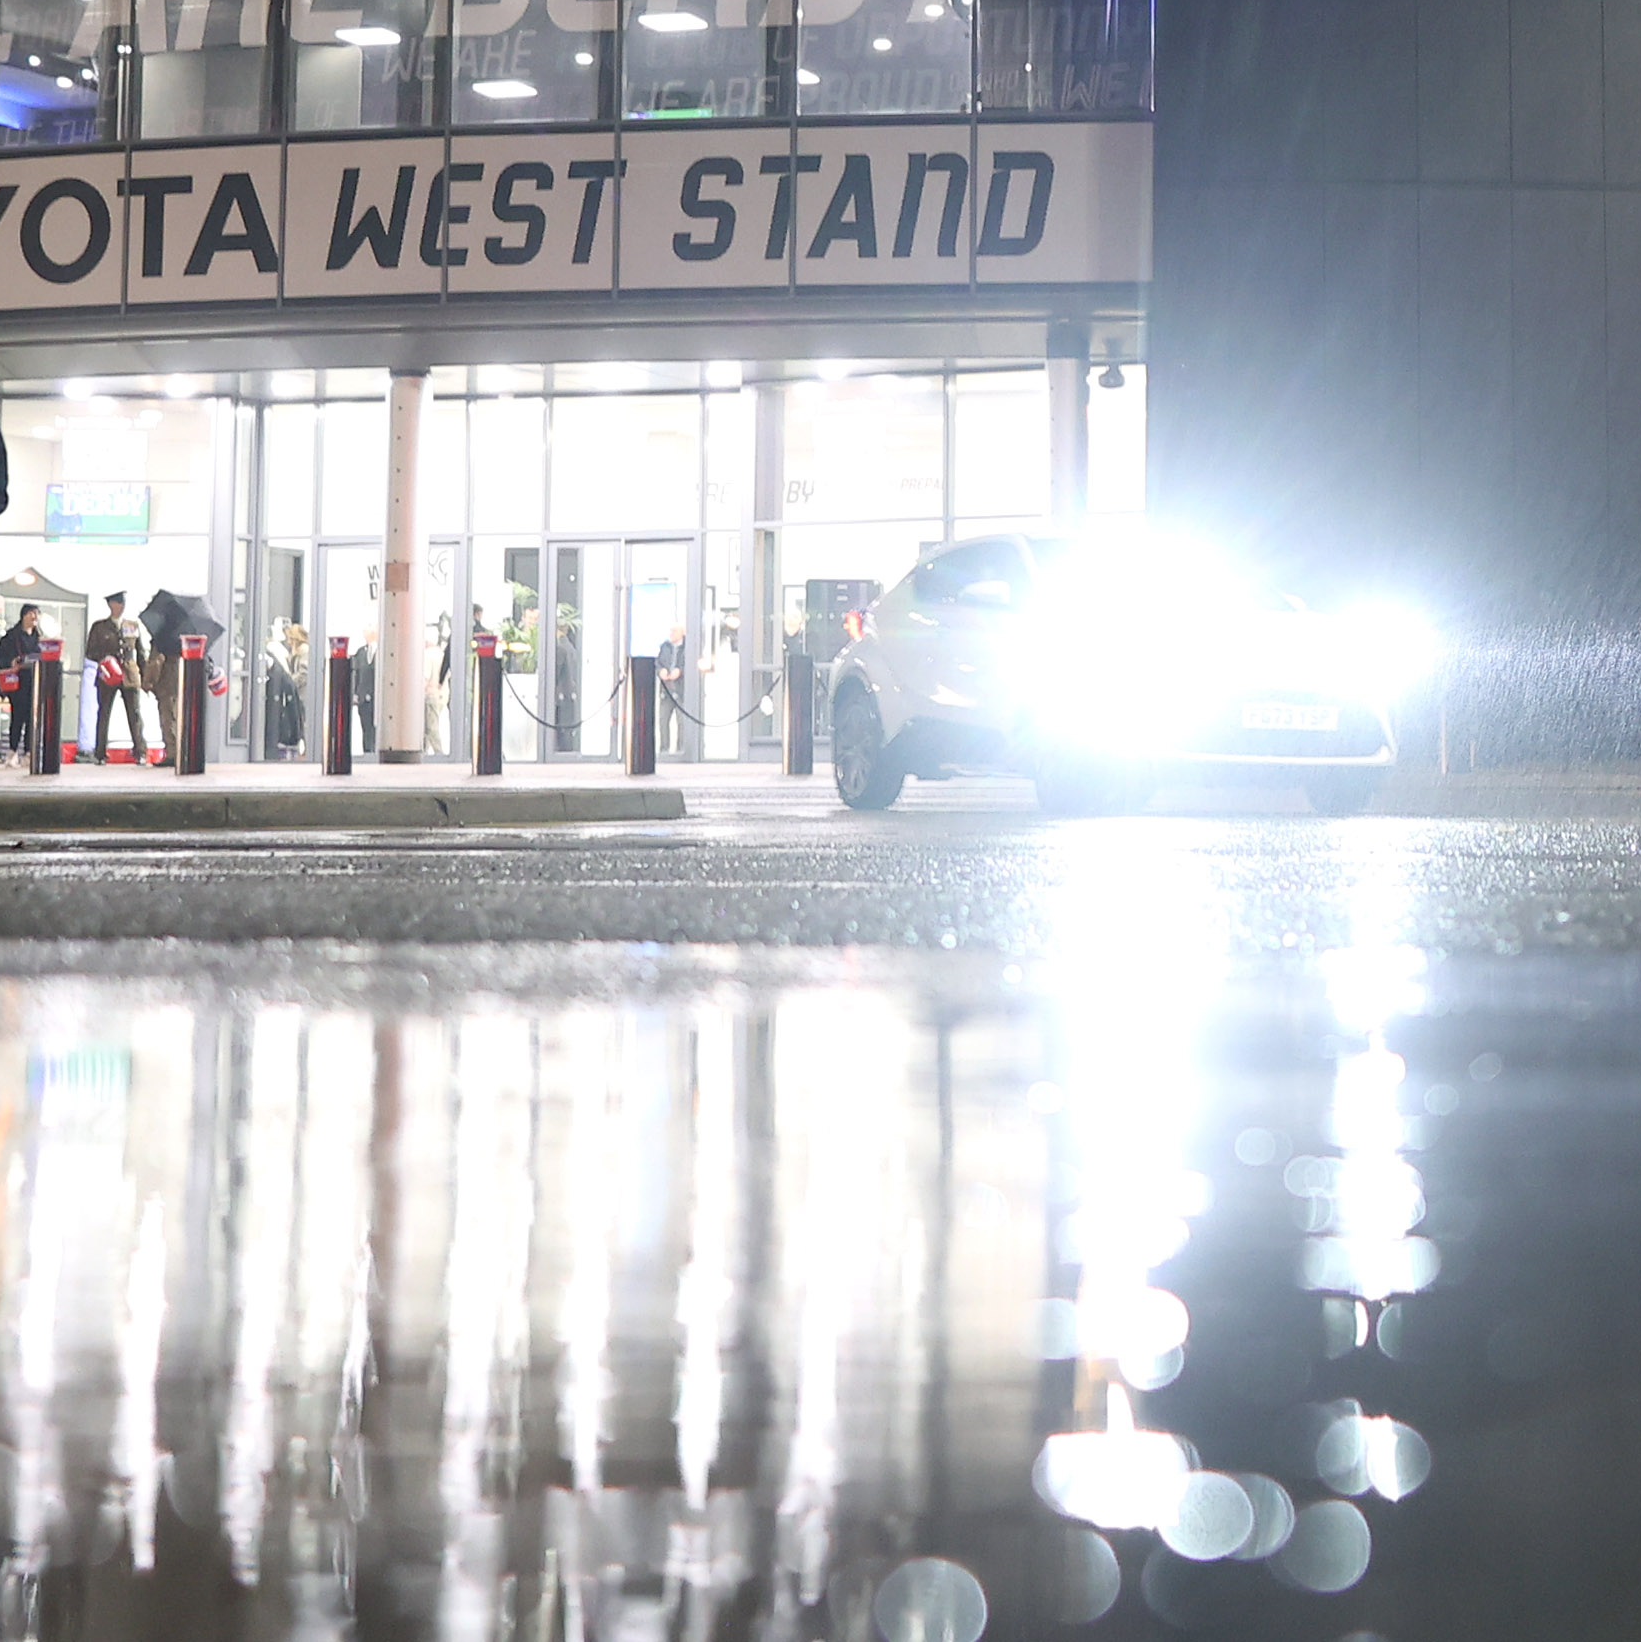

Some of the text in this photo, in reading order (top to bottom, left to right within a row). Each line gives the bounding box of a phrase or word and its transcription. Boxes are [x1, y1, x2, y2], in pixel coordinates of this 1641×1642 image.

[326, 160, 627, 270] WEST
[673, 150, 1055, 261] STAND
[900, 476, 944, 492] PREPA
